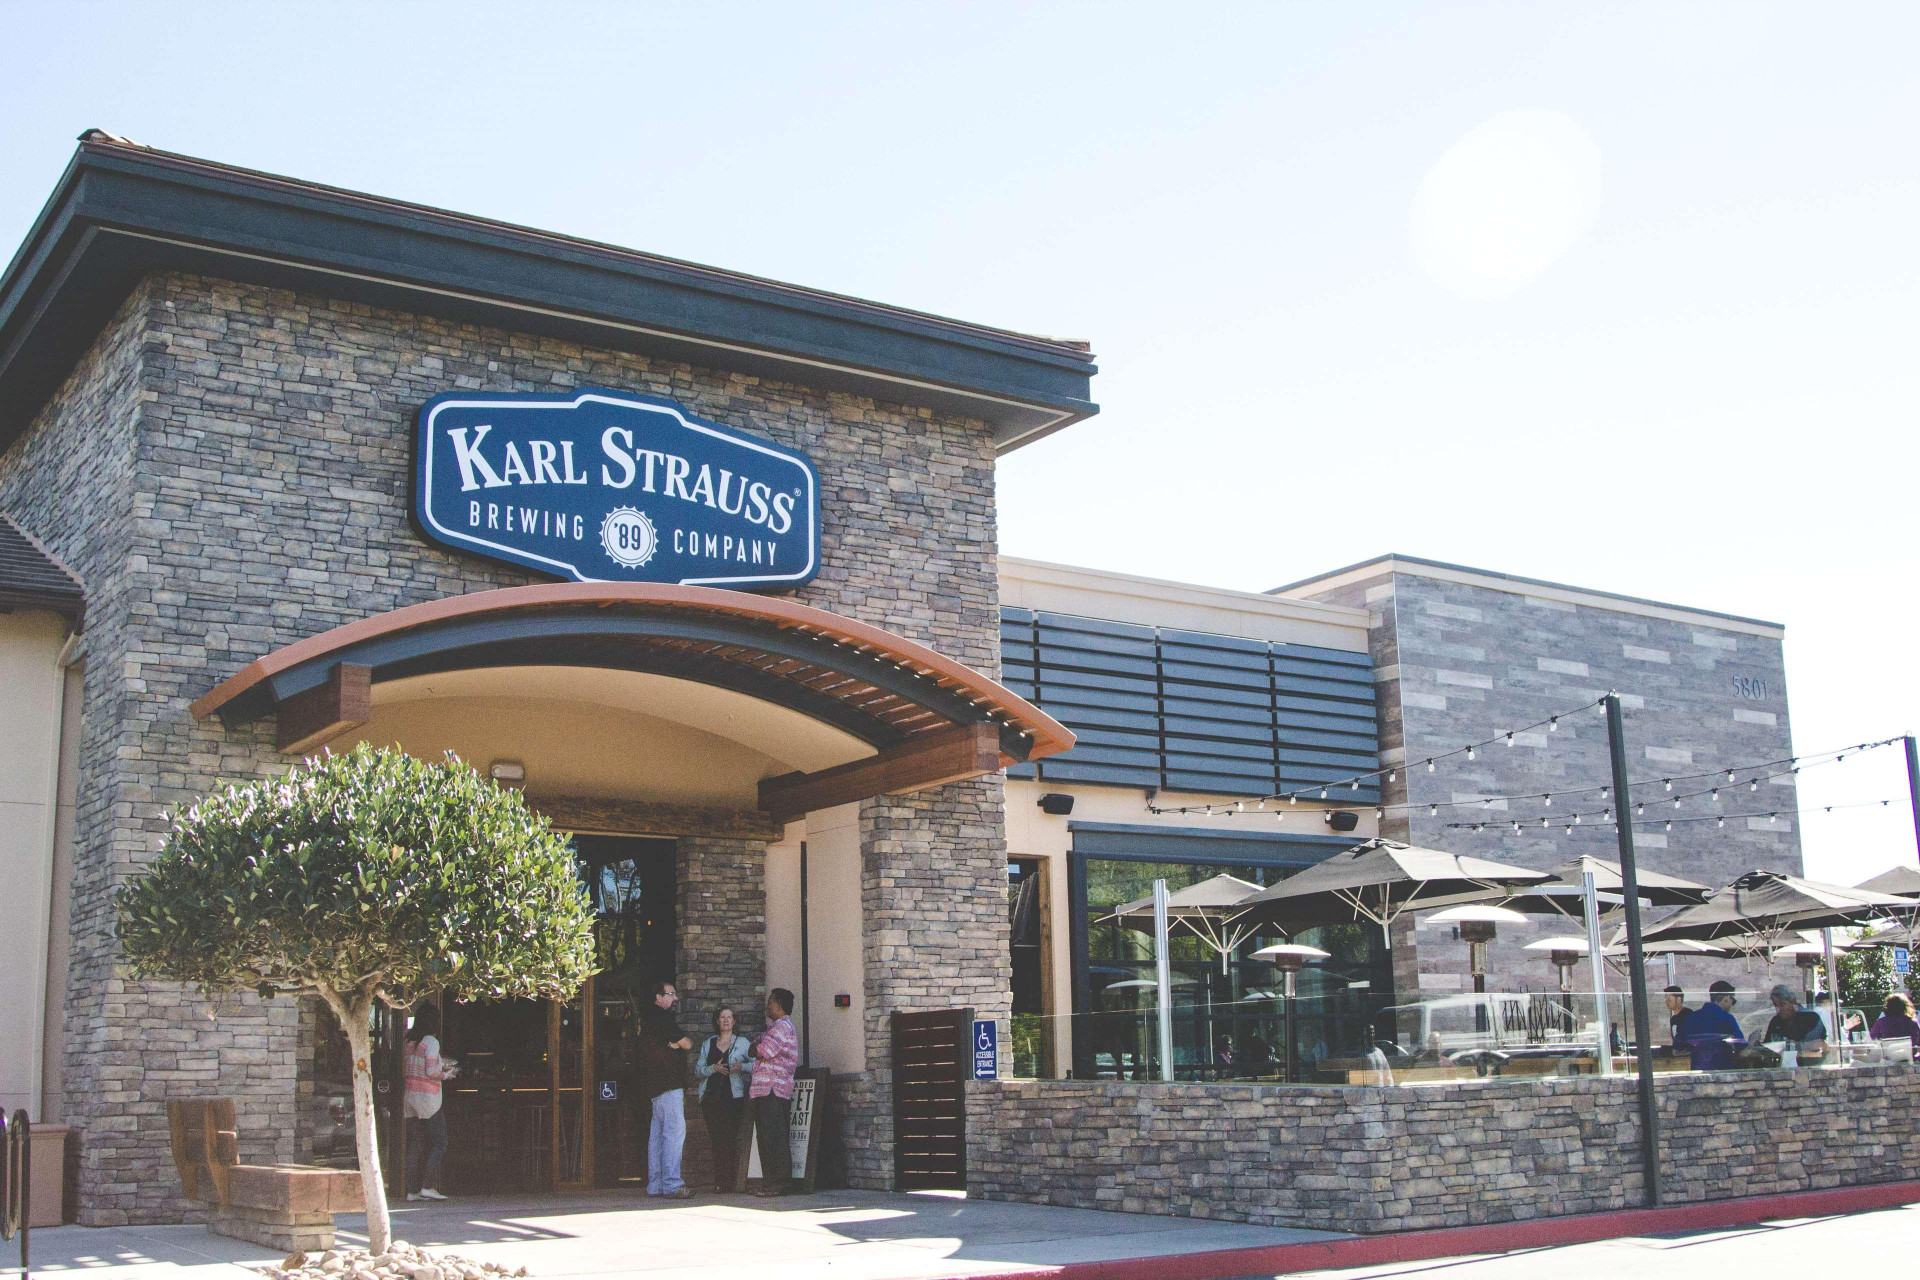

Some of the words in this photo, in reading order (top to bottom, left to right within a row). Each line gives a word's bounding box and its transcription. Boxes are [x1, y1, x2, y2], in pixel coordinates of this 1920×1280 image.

[447, 425, 587, 491] KARL
[469, 500, 584, 541] BREWING
[674, 529, 776, 566] COMPANY
[1732, 674, 1771, 701] 5801
